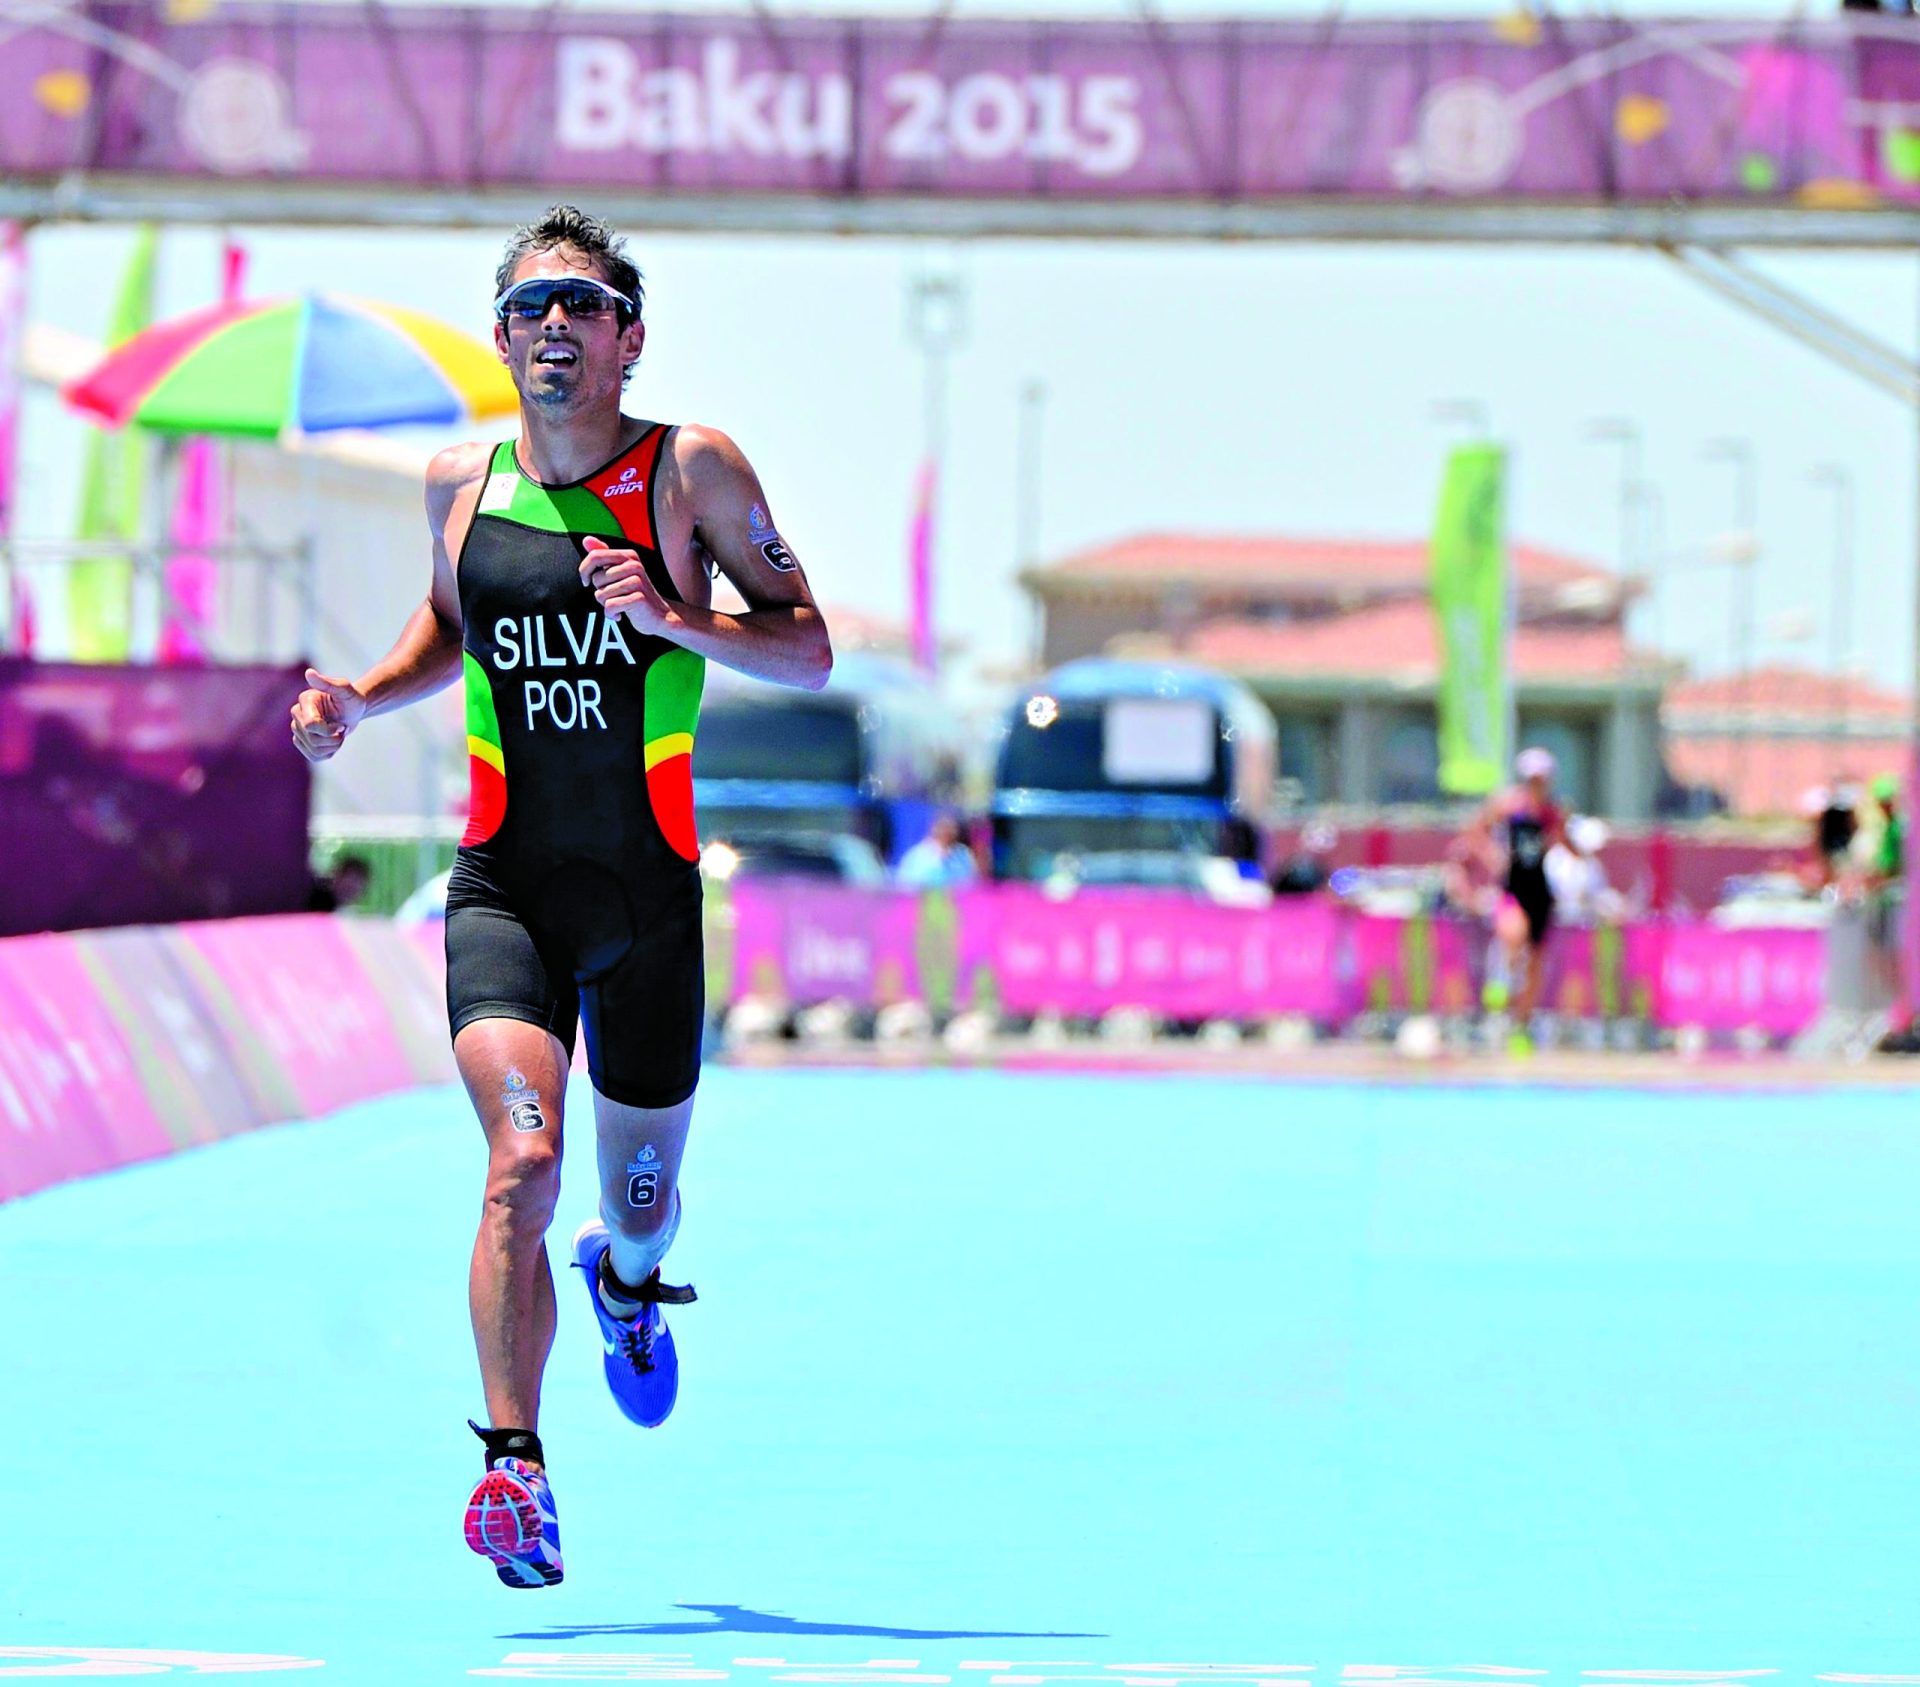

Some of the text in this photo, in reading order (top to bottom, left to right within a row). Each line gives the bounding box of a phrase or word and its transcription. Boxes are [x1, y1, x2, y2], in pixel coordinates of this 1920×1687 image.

[556, 36, 1142, 176] Baku 2015
[494, 612, 636, 669] SILVA
[525, 680, 607, 731] POR
[511, 1102, 545, 1132] 6
[629, 1172, 657, 1207] 6
